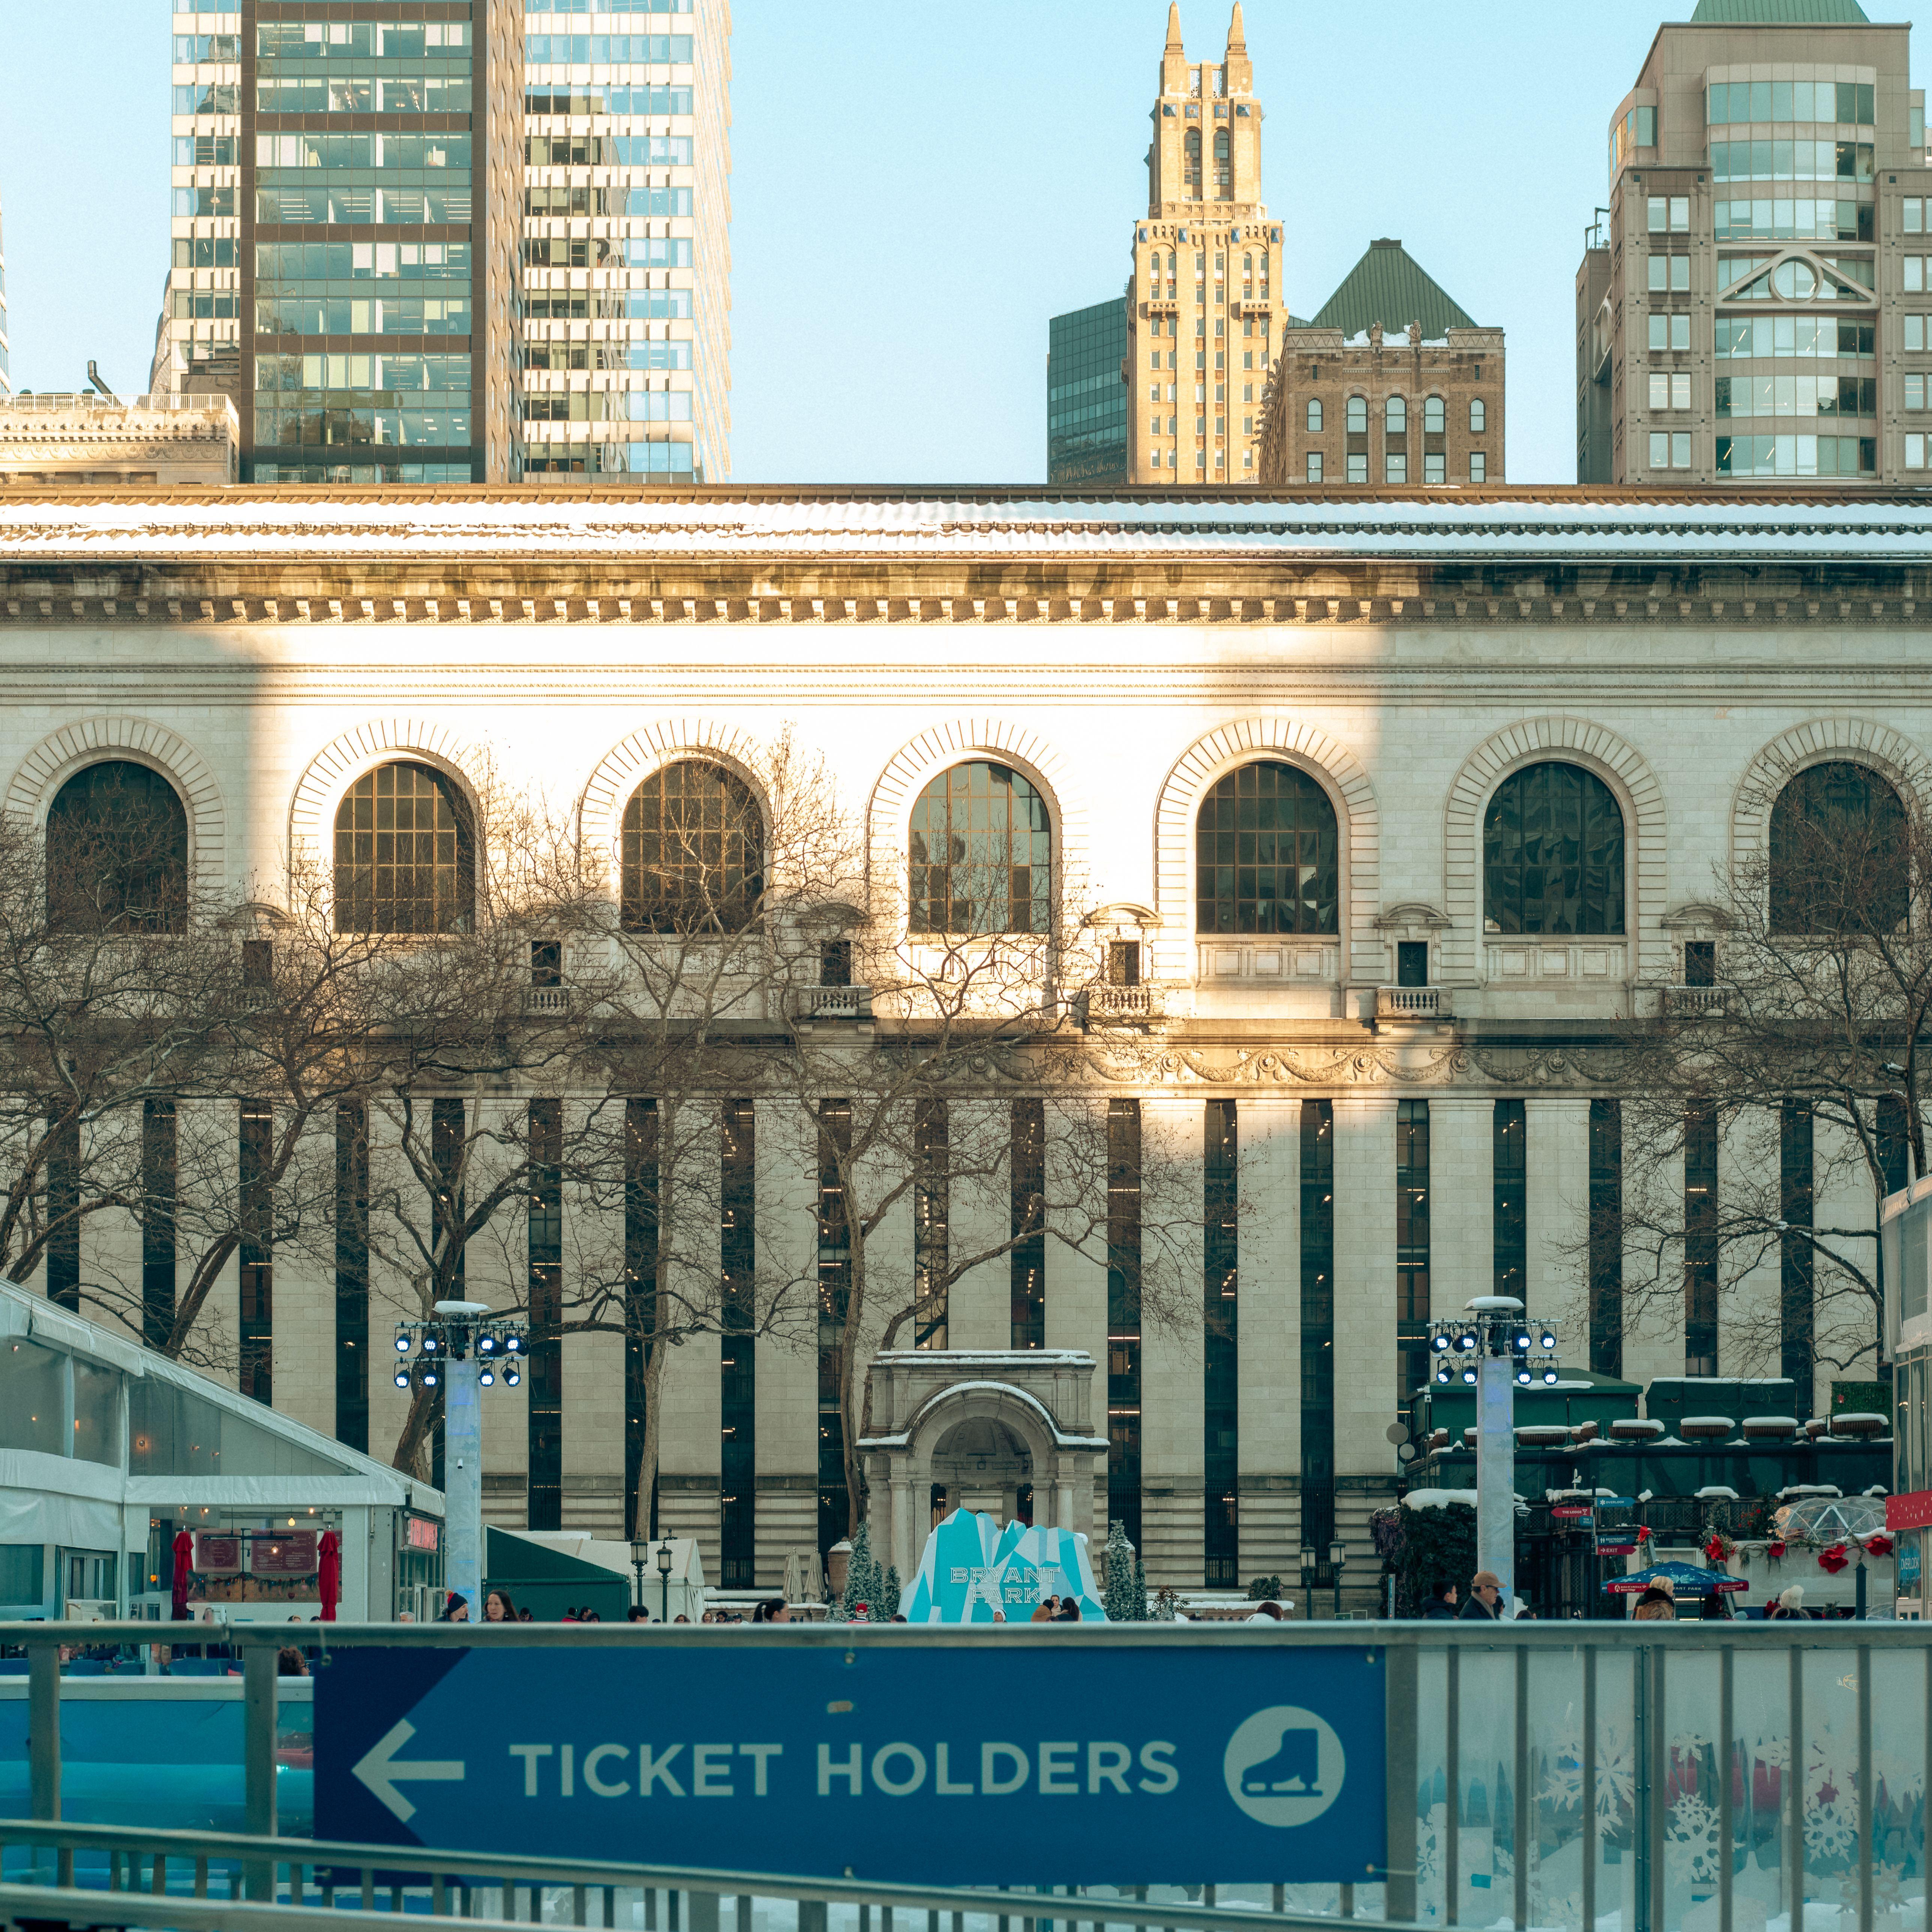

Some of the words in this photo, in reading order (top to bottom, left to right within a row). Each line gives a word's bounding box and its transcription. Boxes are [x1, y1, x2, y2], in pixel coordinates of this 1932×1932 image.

[1901, 1557, 1919, 1570] OVERLOOK
[950, 1567, 1060, 1583] BRYANT
[969, 1587, 1043, 1604] PARK
[510, 1744, 783, 1796] TICKET
[818, 1742, 1178, 1795] HOLDERS
